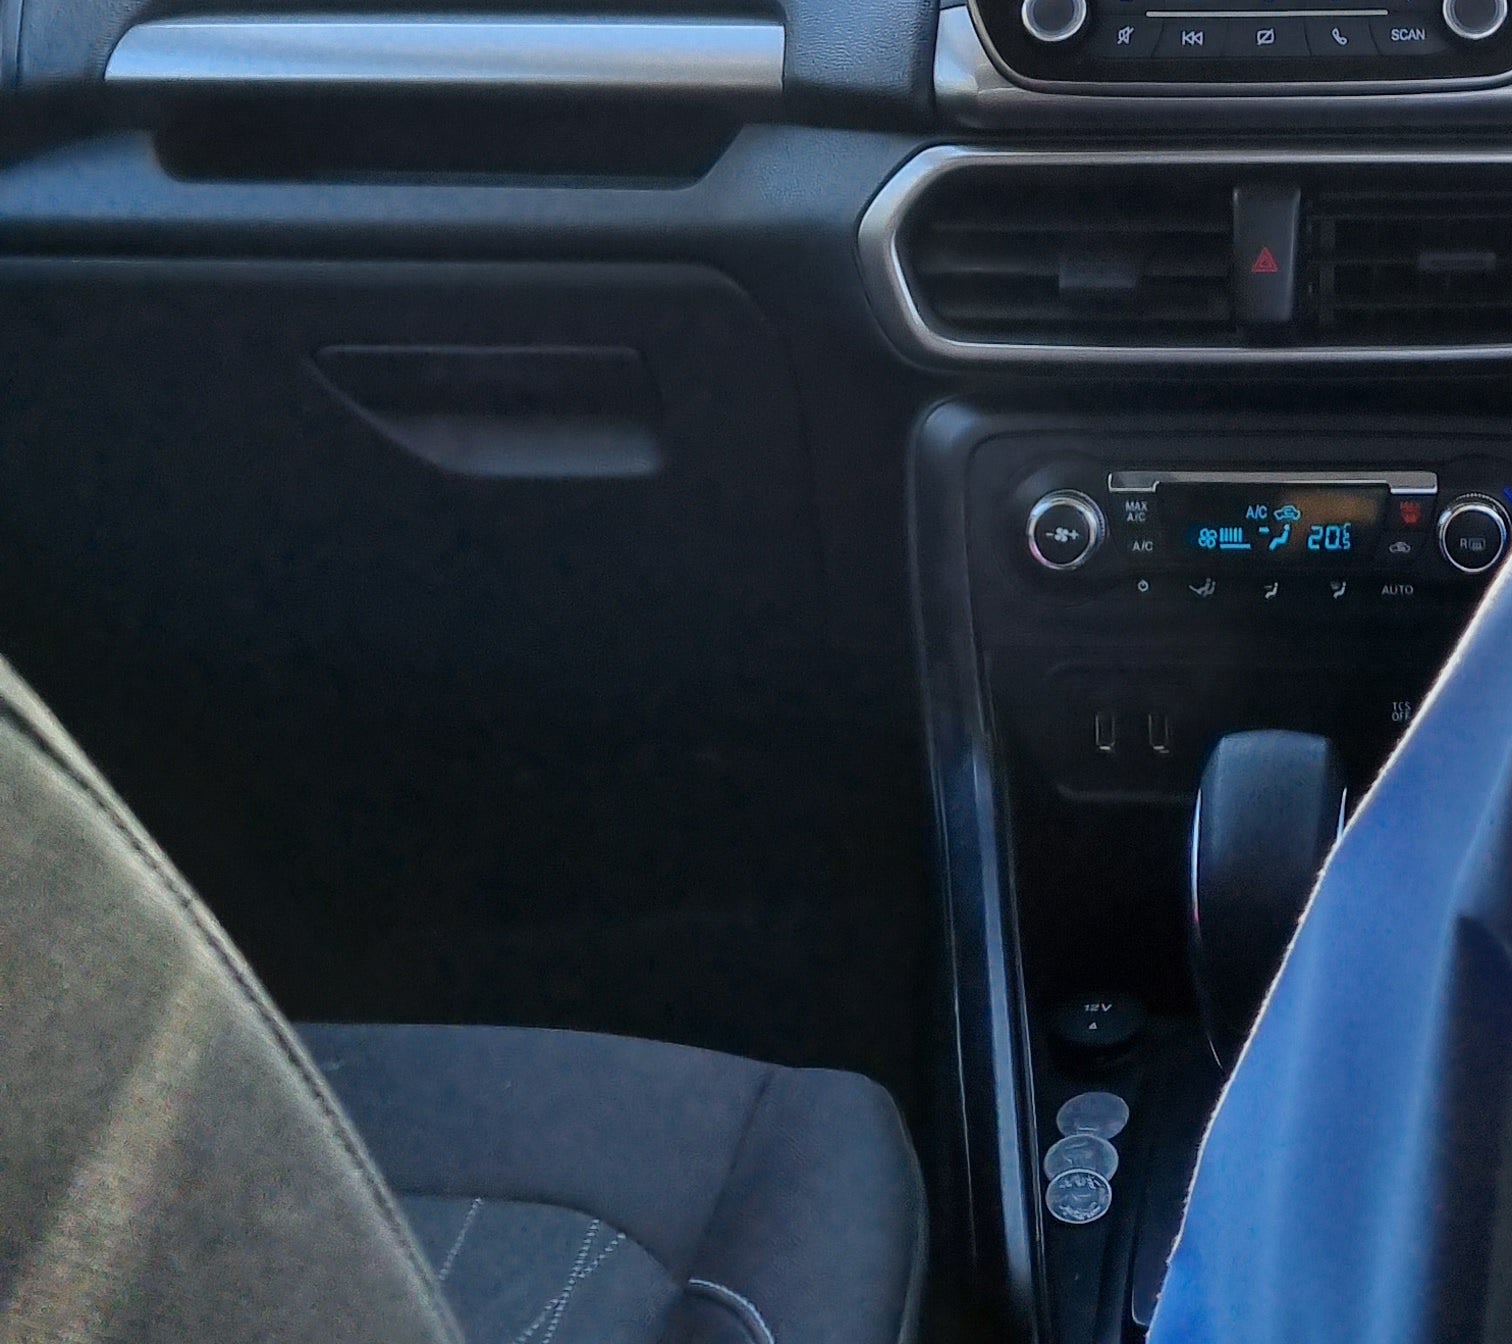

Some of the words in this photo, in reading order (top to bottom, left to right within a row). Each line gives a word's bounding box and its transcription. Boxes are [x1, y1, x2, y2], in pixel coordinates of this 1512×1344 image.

[1391, 29, 1426, 41] SCAN
[1125, 501, 1149, 512] MAX
[1245, 505, 1268, 519] A/C
[1126, 512, 1147, 523] A/C
[1131, 540, 1154, 553] A/C
[1381, 584, 1414, 596] AUTO
[1392, 701, 1411, 712] TCS
